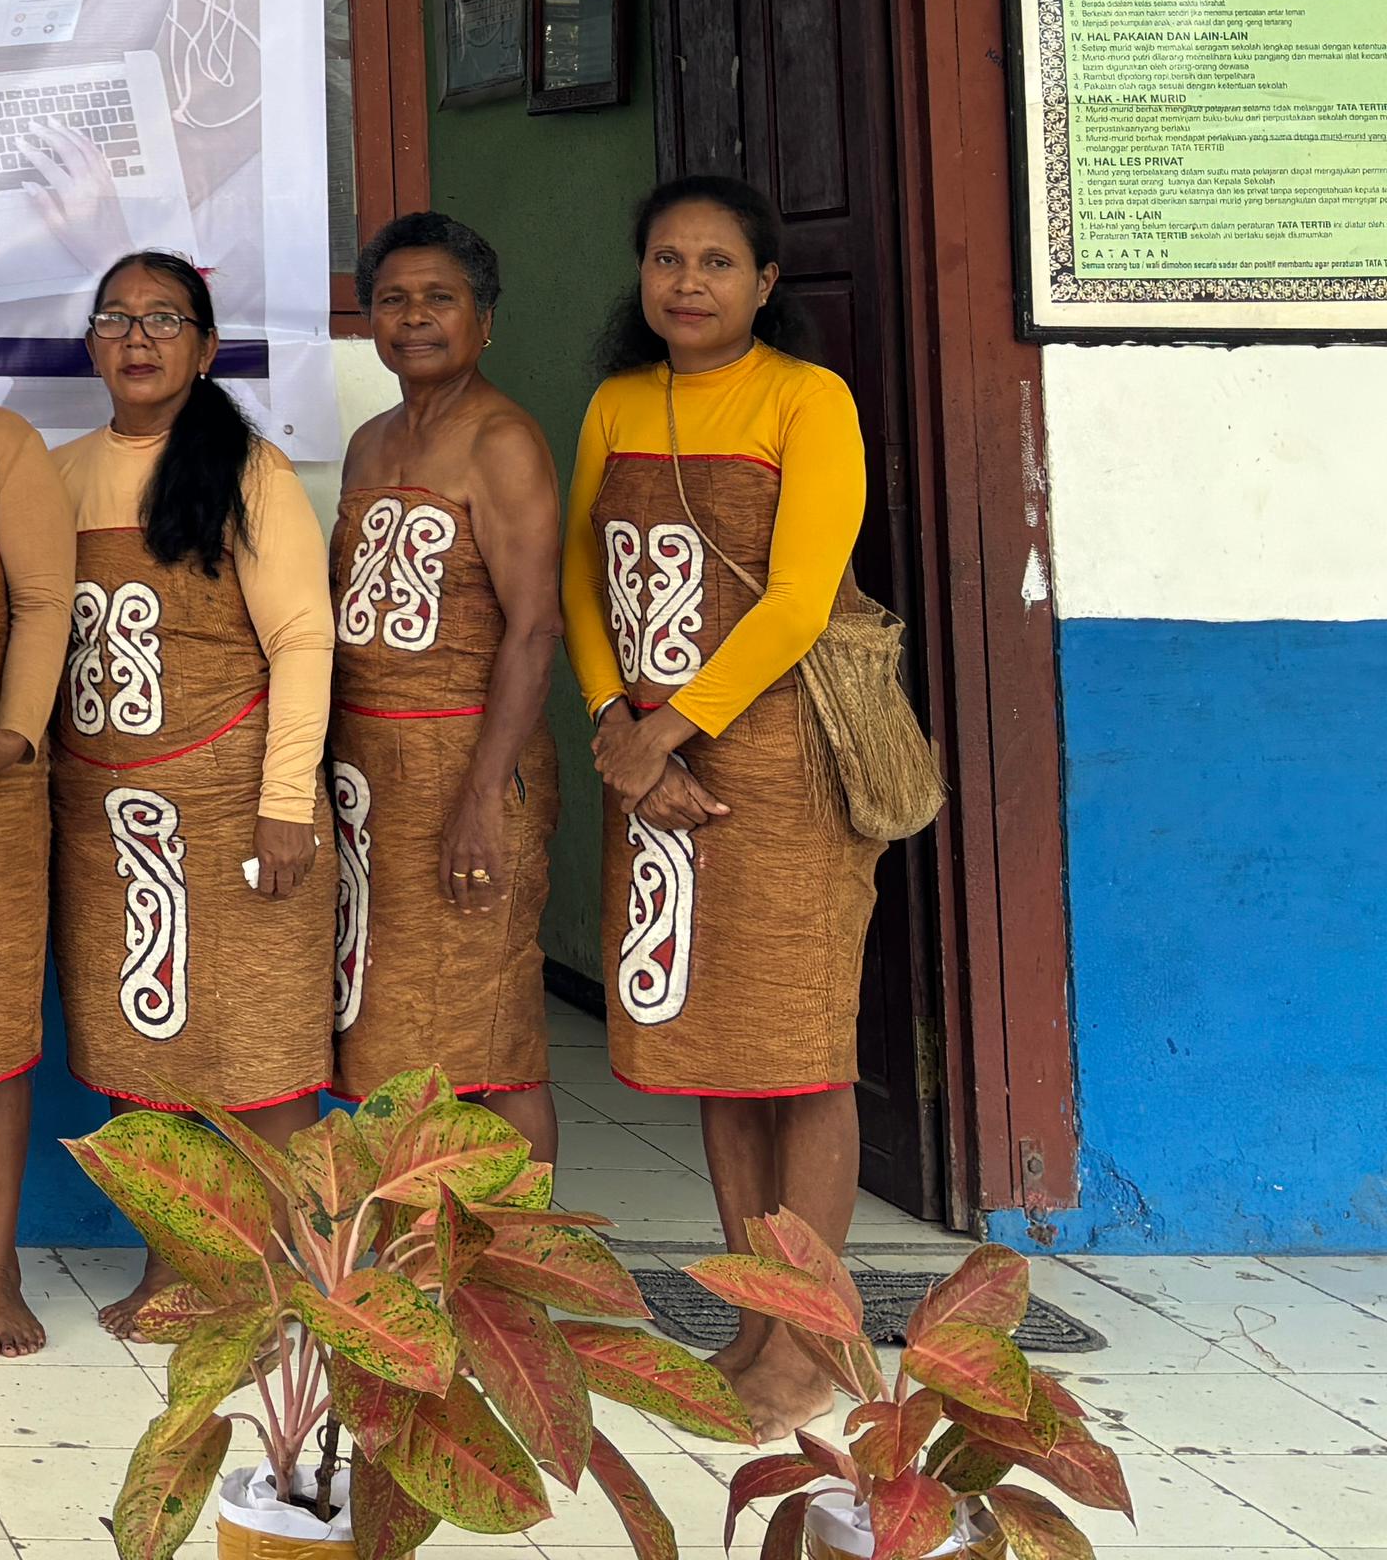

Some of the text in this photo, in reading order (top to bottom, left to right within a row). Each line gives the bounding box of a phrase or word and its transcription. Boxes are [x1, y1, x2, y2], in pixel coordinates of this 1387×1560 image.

[1071, 32, 1249, 41] IV. HAL PAKAIAN DAN LAIN-LAIN
[1186, 82, 1216, 91] dengan
[1075, 95, 1086, 104] V.
[1088, 94, 1113, 103] HAK
[1122, 94, 1147, 103] HAK
[1150, 94, 1187, 103] MURID
[1171, 144, 1192, 152] TATA
[1194, 144, 1225, 152] TERTIB
[1076, 157, 1184, 167] VI. HAL LES PRIVAT
[1079, 211, 1097, 220] VII.
[1099, 211, 1126, 220] LAIN
[1135, 211, 1162, 220] LAIN
[1089, 231, 1130, 240] Peraturan
[1132, 232, 1154, 240] TATA
